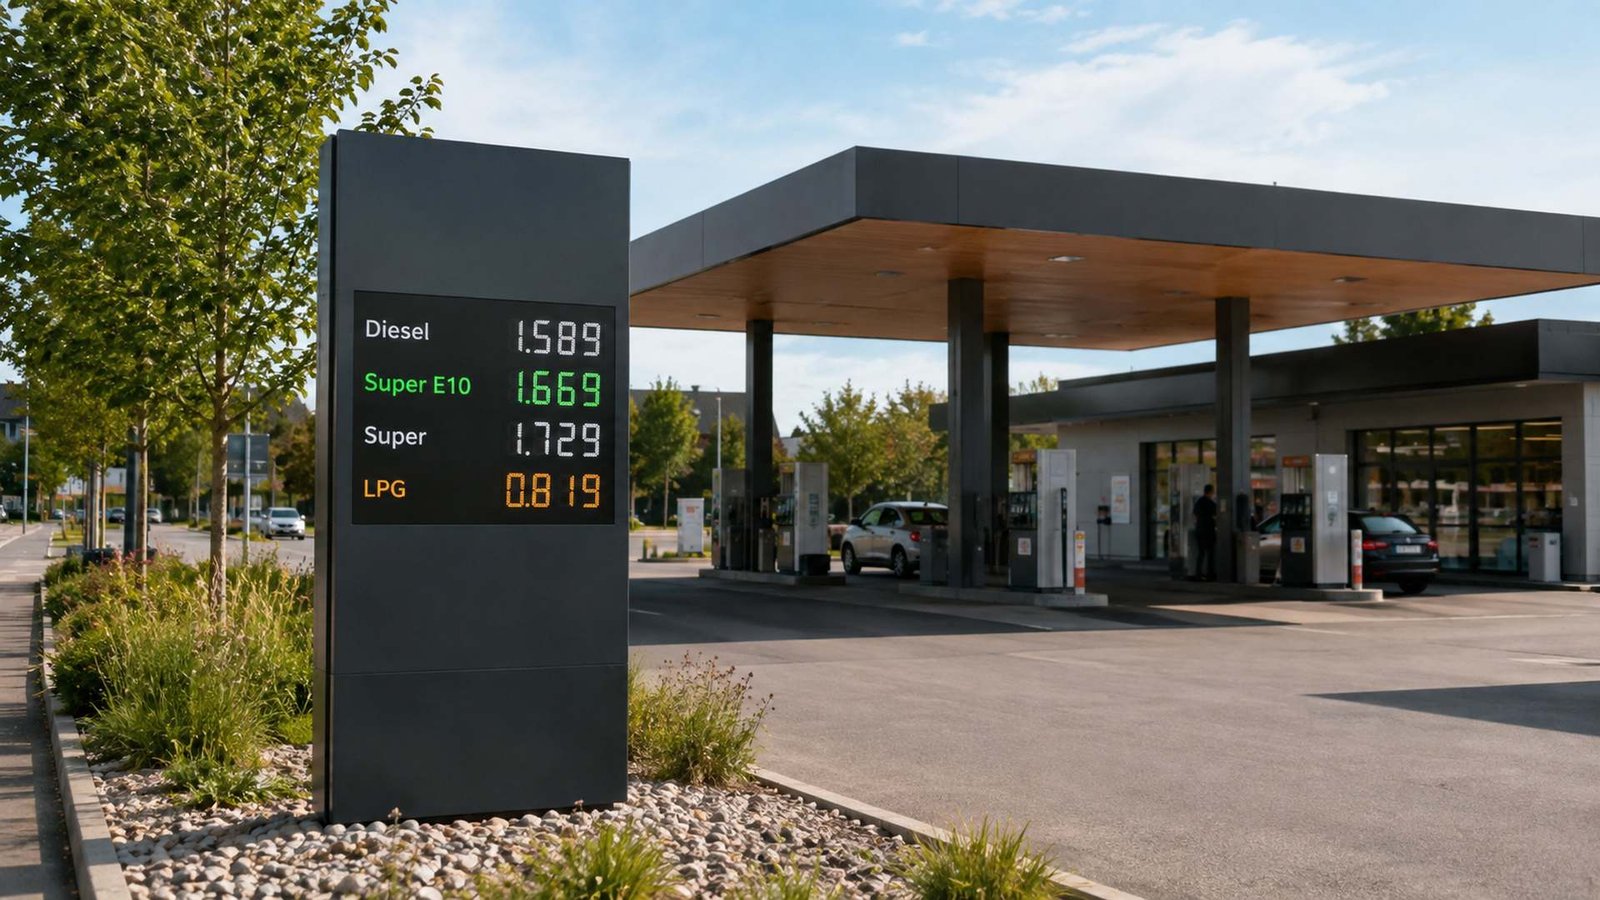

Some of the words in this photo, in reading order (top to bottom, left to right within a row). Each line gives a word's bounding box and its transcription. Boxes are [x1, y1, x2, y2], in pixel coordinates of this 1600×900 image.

[365, 320, 429, 340] Diesel
[517, 320, 600, 356] 1.589
[364, 373, 427, 396] Super
[433, 376, 471, 395] E10
[517, 371, 600, 407] 1.669
[364, 426, 427, 449] Super
[516, 422, 600, 457] 1.729
[364, 480, 406, 498] LPG
[506, 473, 600, 508] 0.819
